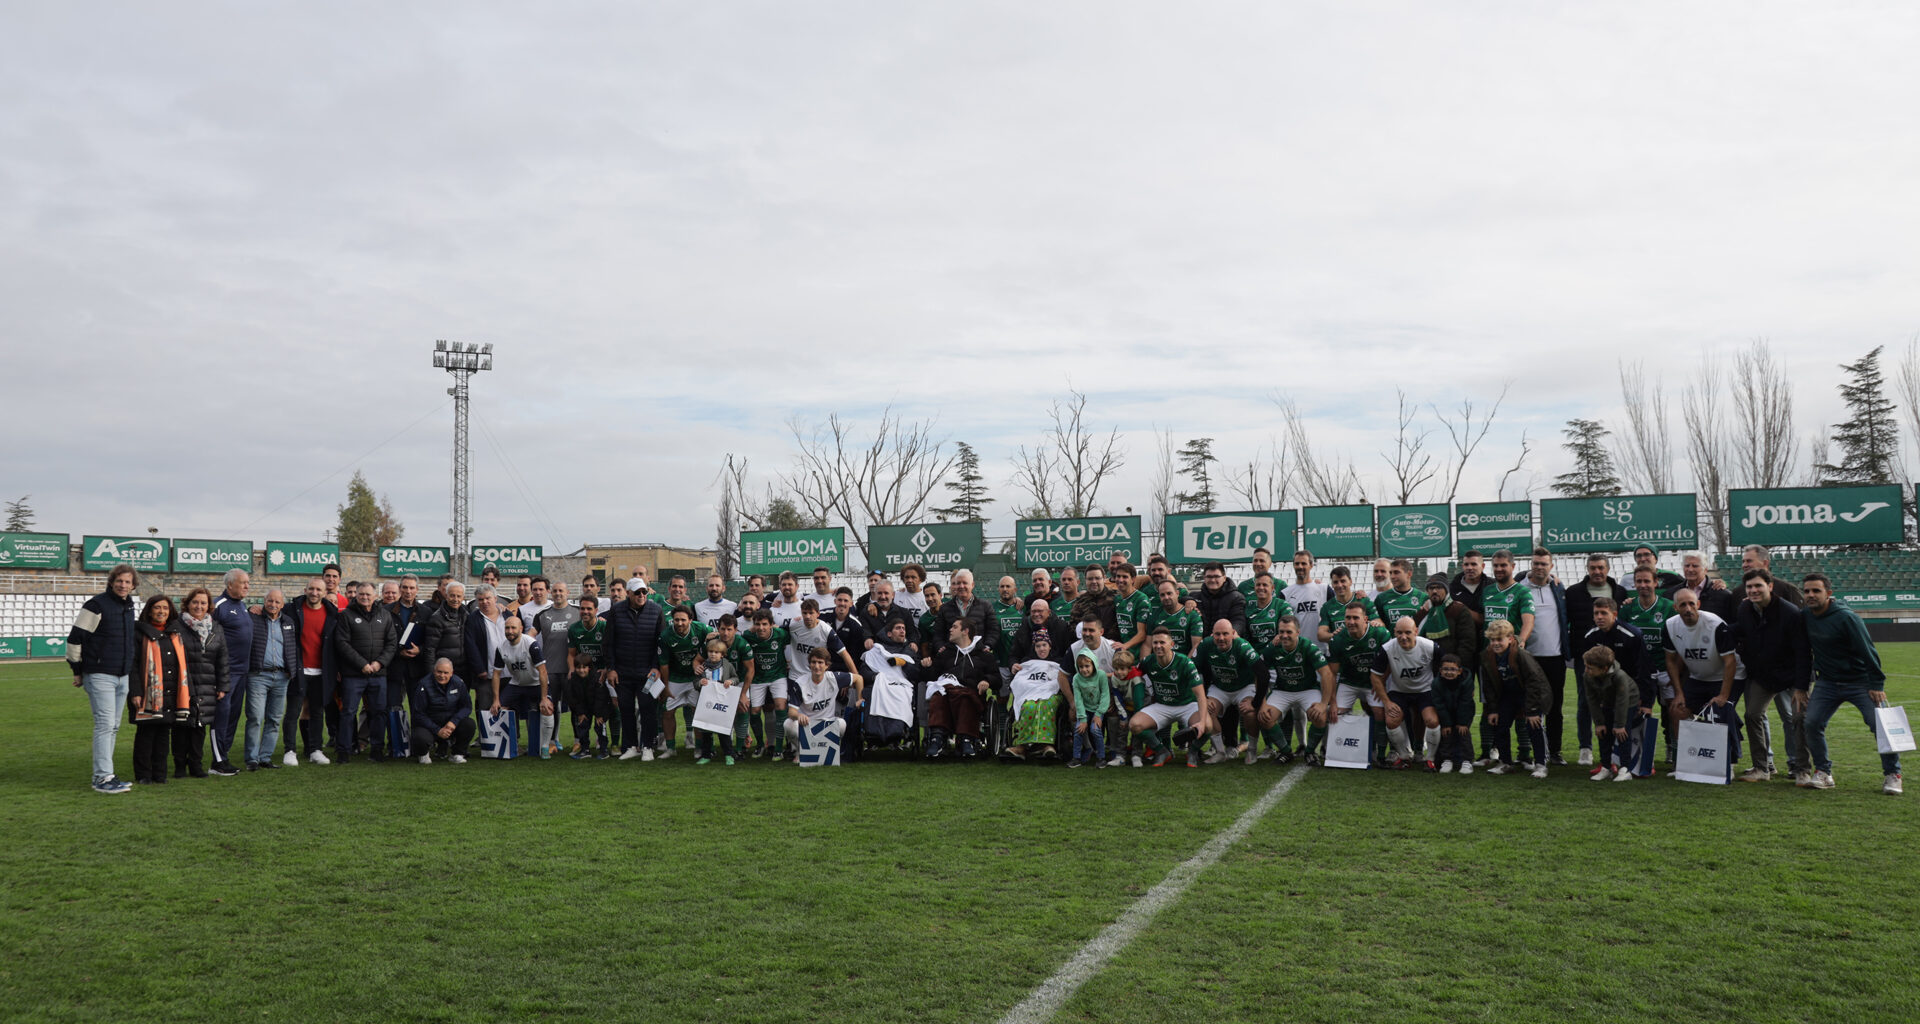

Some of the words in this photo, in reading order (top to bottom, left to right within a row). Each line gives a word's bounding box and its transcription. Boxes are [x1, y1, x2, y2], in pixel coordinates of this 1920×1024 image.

[1192, 525, 1268, 550] Tello
[1547, 527, 1621, 543] Sánchez
[1623, 525, 1694, 540] Garrido
[91, 539, 158, 559] Astral
[768, 540, 838, 556] HULOMA
[1025, 549, 1070, 562] Motor
[1075, 546, 1131, 560] Pacífio
[210, 548, 249, 561] alonso
[290, 552, 337, 564] LIMASA
[382, 549, 446, 563] GRADA
[474, 549, 541, 562] SOCIAL
[768, 556, 799, 564] promotora
[802, 554, 838, 562] inmobiliaria
[886, 554, 923, 564] TEJAR
[926, 553, 961, 564] VIEJO
[908, 608, 921, 618] FE
[1297, 601, 1317, 613] AFE
[551, 621, 568, 631] AFE
[708, 619, 720, 628] AF
[1684, 648, 1708, 660] AFE
[1027, 671, 1047, 681] AFE
[1400, 666, 1423, 678] AFE
[713, 703, 728, 712] AFE
[1343, 738, 1360, 747] AFE
[1697, 747, 1716, 758] AFE
